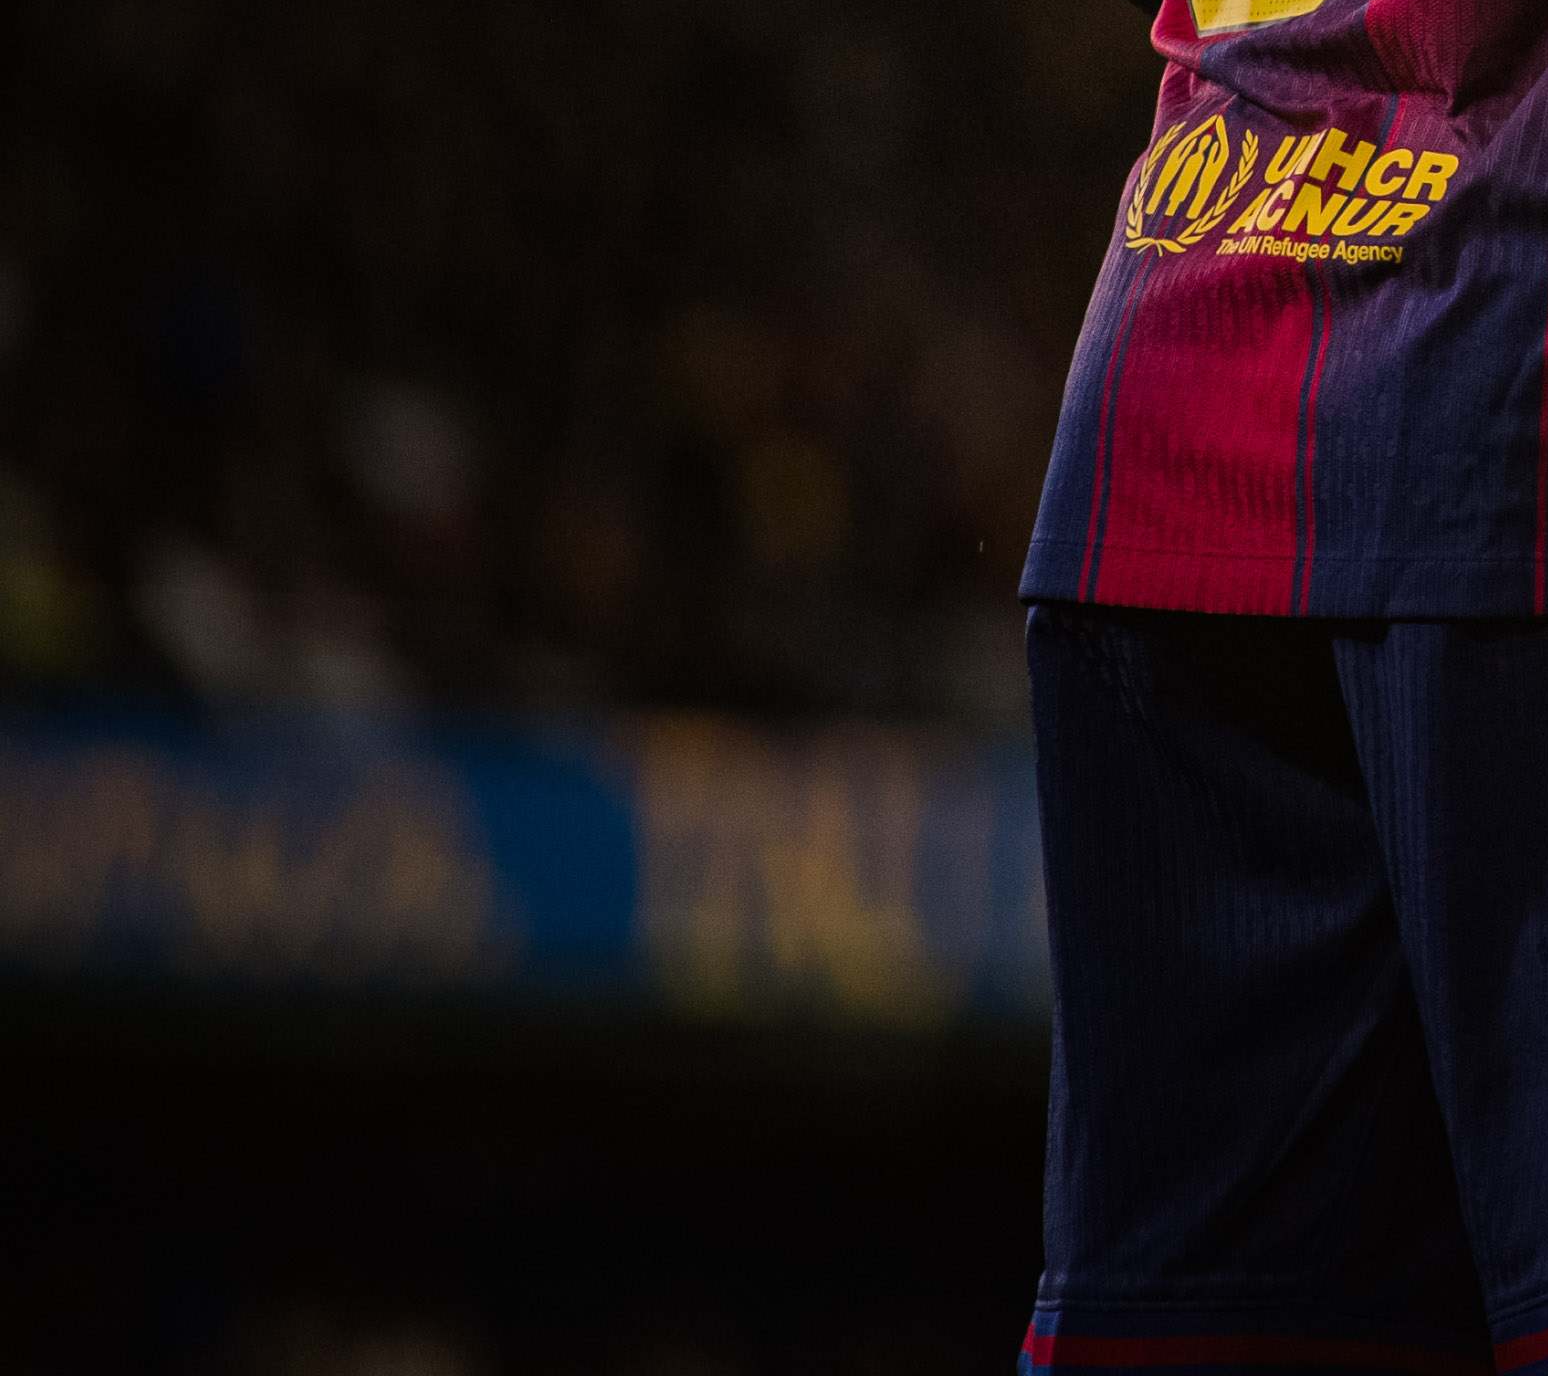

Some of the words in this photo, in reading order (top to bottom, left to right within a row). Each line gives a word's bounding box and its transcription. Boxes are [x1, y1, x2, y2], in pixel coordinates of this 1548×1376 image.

[1226, 180, 1431, 237] ACNUR
[1239, 236, 1263, 256] UN
[1263, 236, 1329, 263] Refugee
[1333, 241, 1404, 265] Agency
